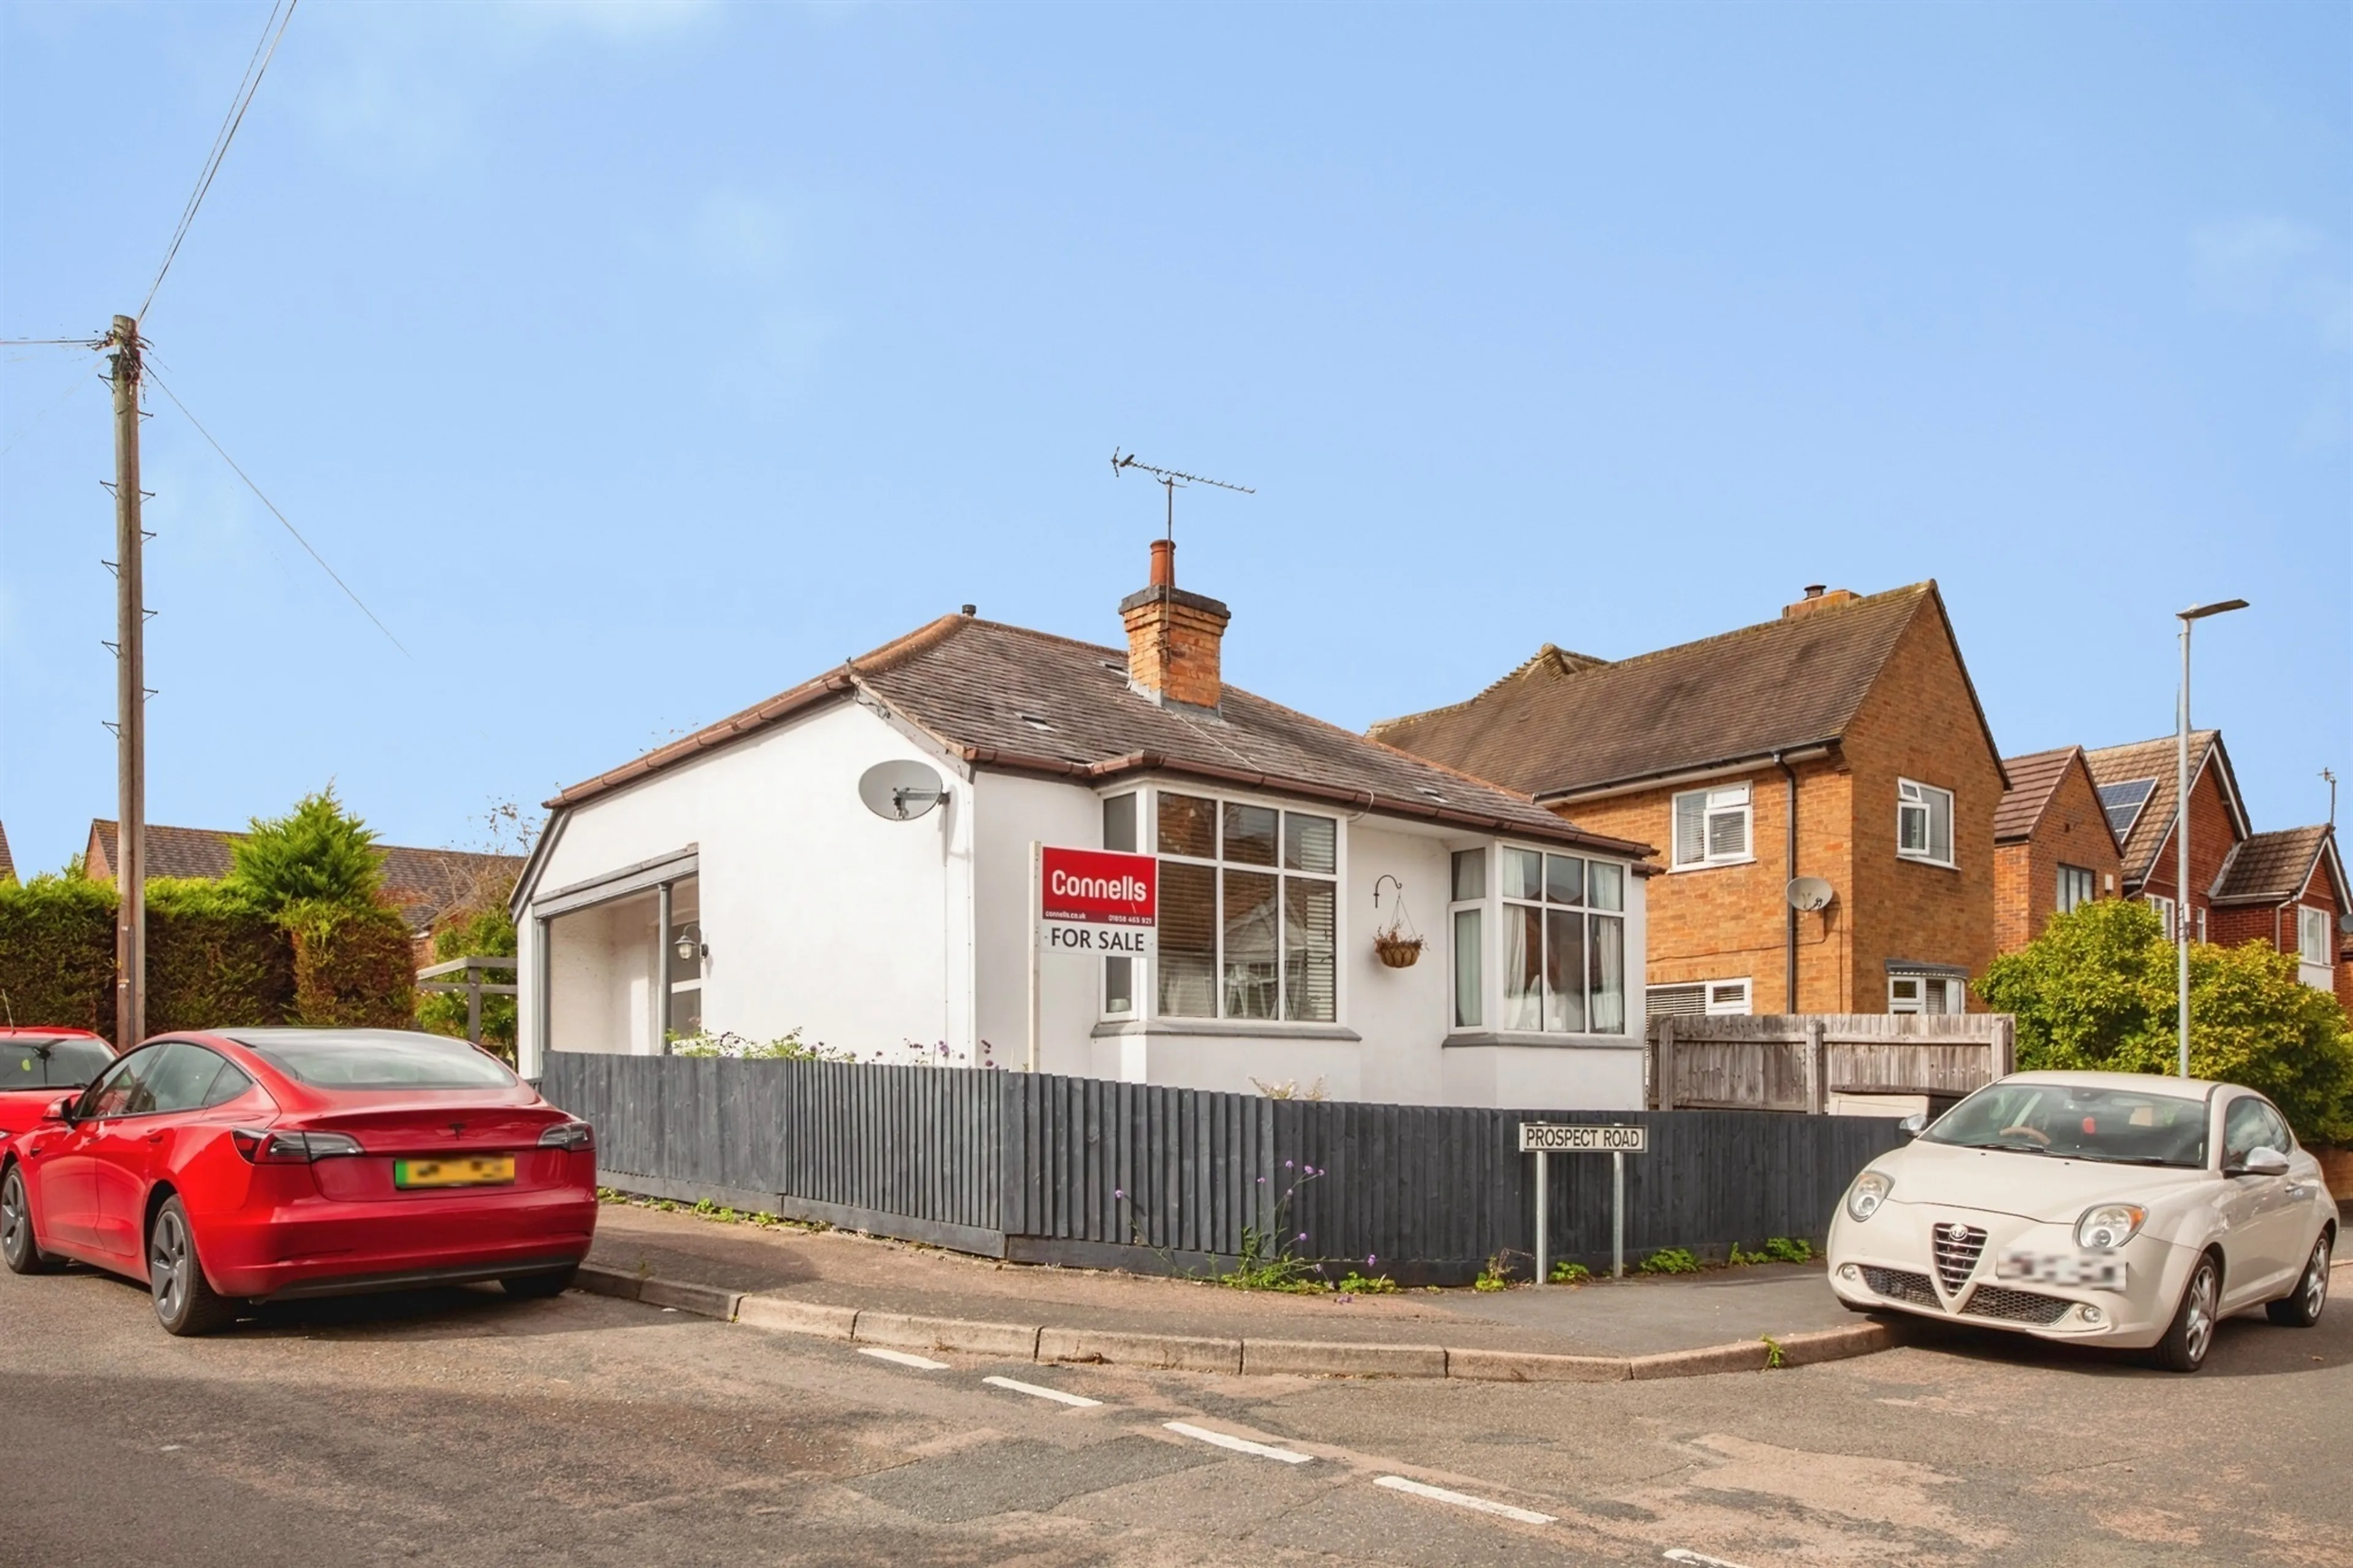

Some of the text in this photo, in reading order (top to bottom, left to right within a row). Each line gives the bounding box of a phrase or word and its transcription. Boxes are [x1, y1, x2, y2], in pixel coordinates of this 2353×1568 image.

[1051, 869, 1147, 903] Connells
[1045, 911, 1086, 920] connells.co.uk
[1108, 914, 1127, 923] 01858
[1051, 927, 1145, 952] FOR SALE
[1526, 1128, 1640, 1147] PROSPECT ROAD
